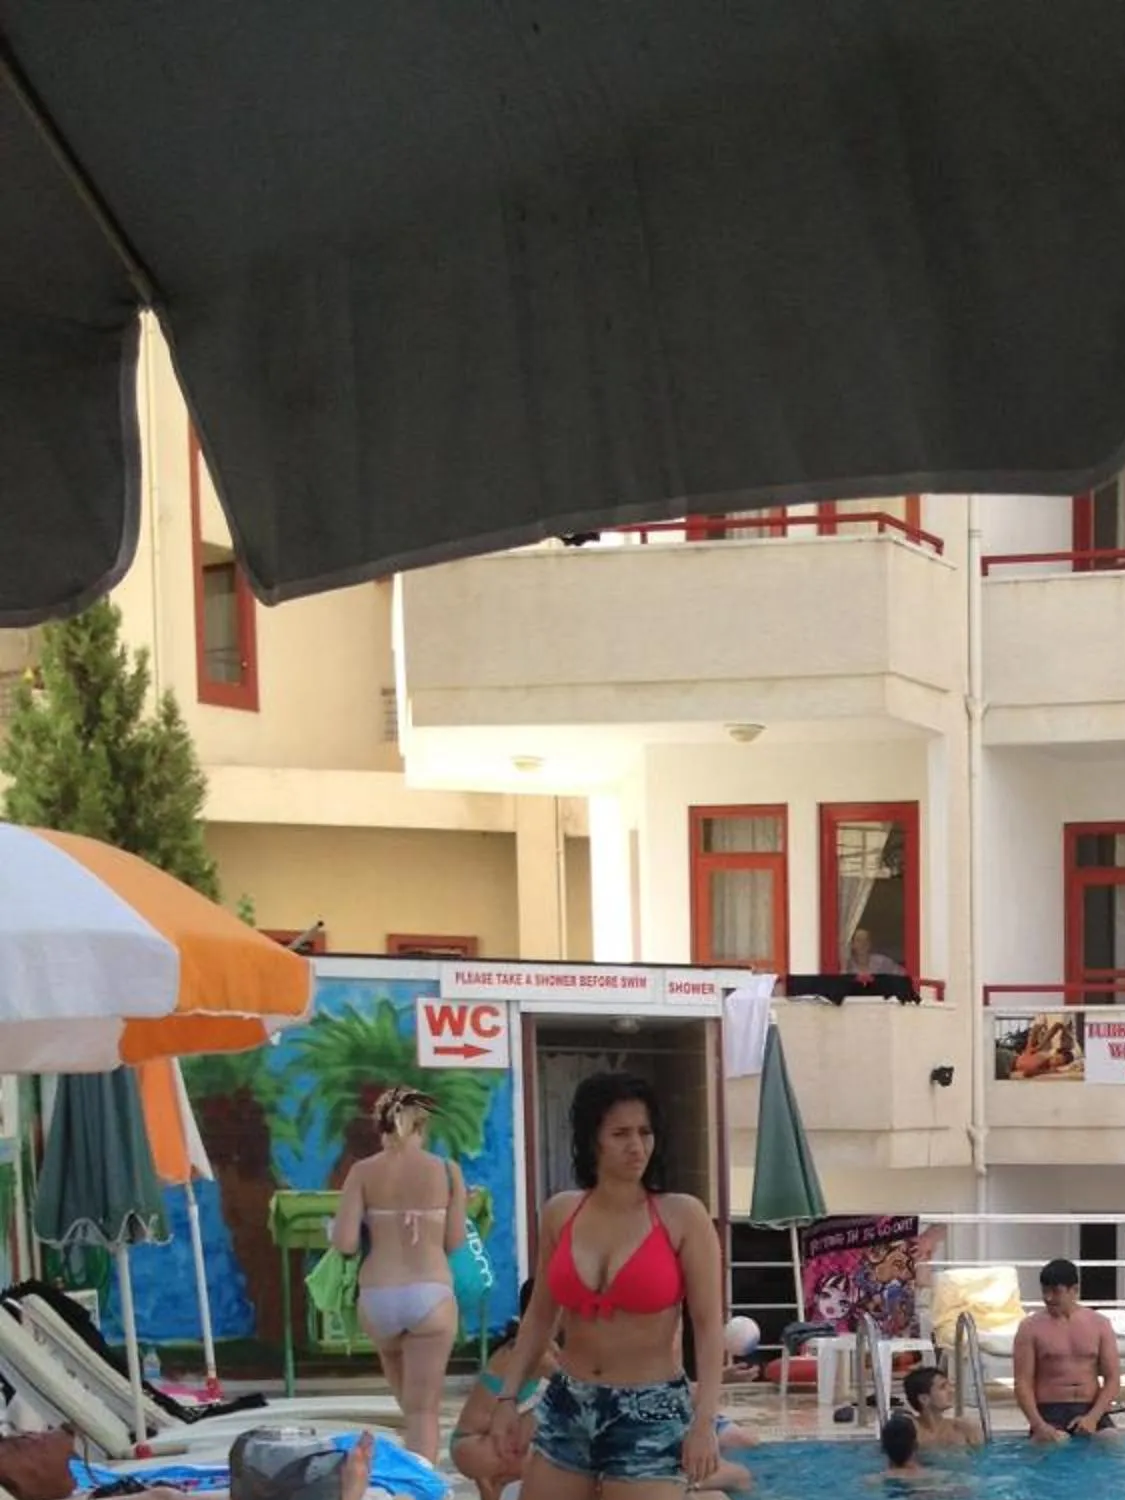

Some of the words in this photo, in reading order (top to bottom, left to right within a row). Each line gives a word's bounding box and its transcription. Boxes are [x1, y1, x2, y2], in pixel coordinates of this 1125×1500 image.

[455, 971, 493, 985] PLEASE
[496, 973, 522, 986] TAKE
[525, 975, 532, 986] A
[535, 974, 577, 987] SHOWER
[579, 975, 619, 989] BEFORE
[621, 976, 647, 989] SWIM
[668, 981, 715, 995] SHOWER
[424, 1005, 501, 1038] WC
